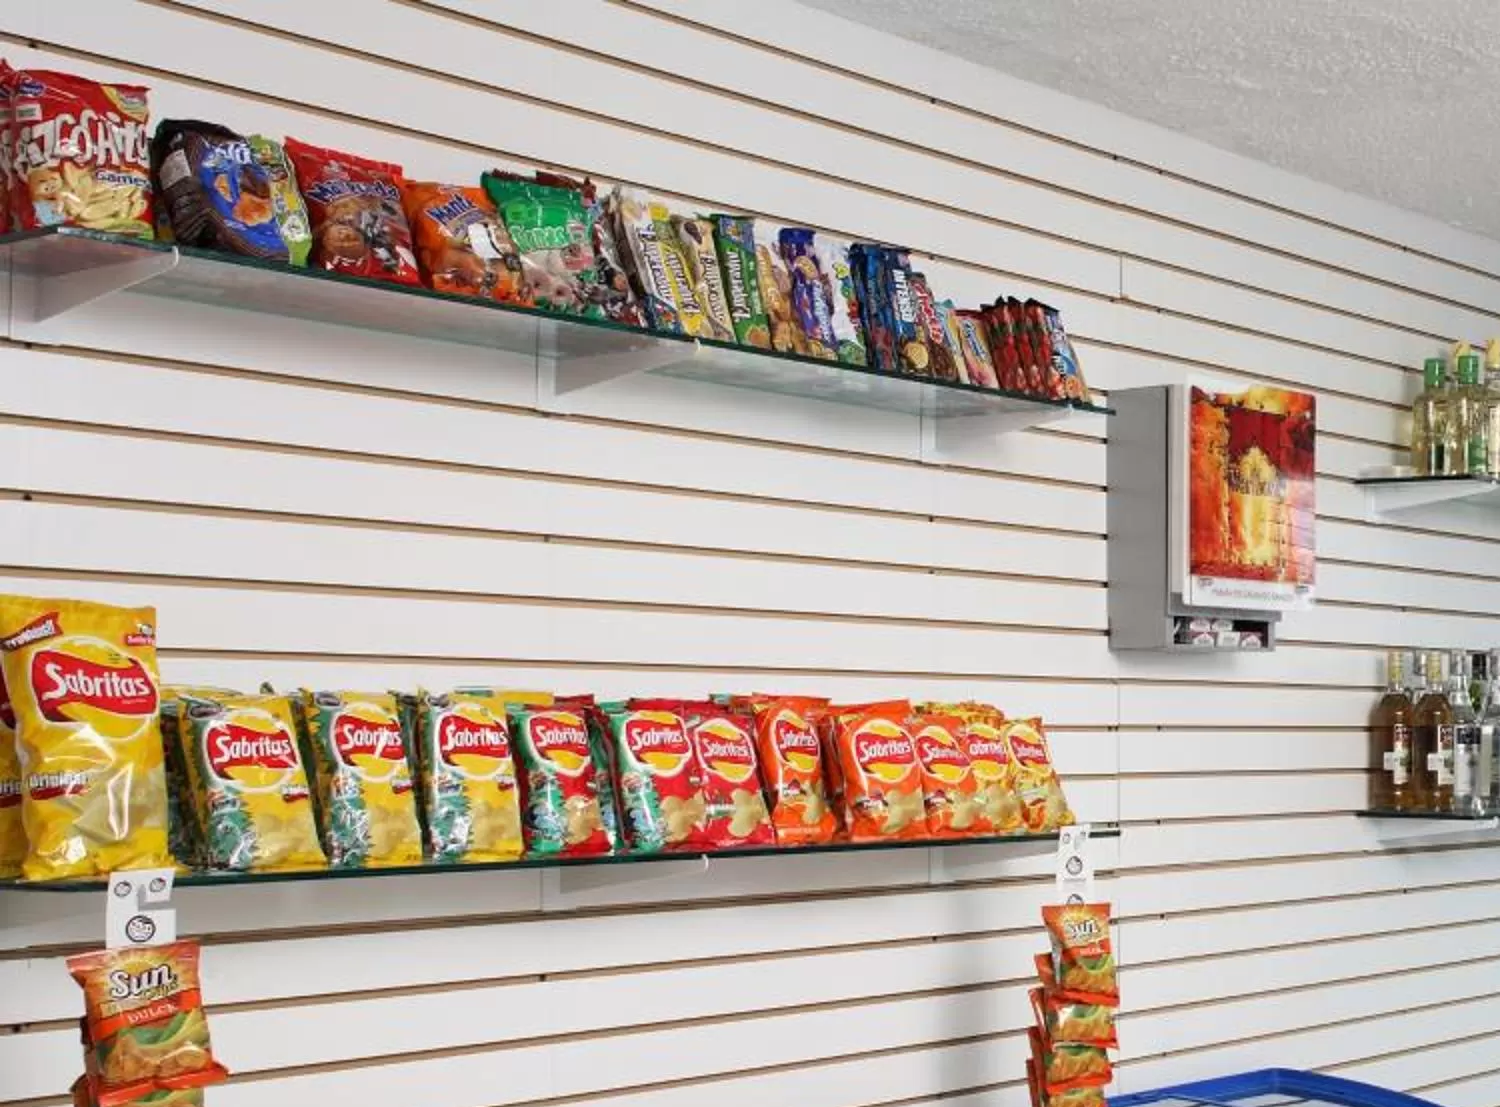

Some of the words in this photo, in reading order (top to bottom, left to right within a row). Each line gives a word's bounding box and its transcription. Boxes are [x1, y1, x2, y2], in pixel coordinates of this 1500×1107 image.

[42, 663, 150, 701] Sabritas
[341, 724, 401, 749] Sabritas
[442, 725, 507, 750] Sabritas
[535, 725, 587, 747] Sabritas
[631, 728, 683, 750] Sabritas
[214, 735, 290, 764] Sabritas
[703, 741, 748, 758] Sabritas
[857, 740, 911, 763] Sabritas
[109, 963, 176, 999] Sun
